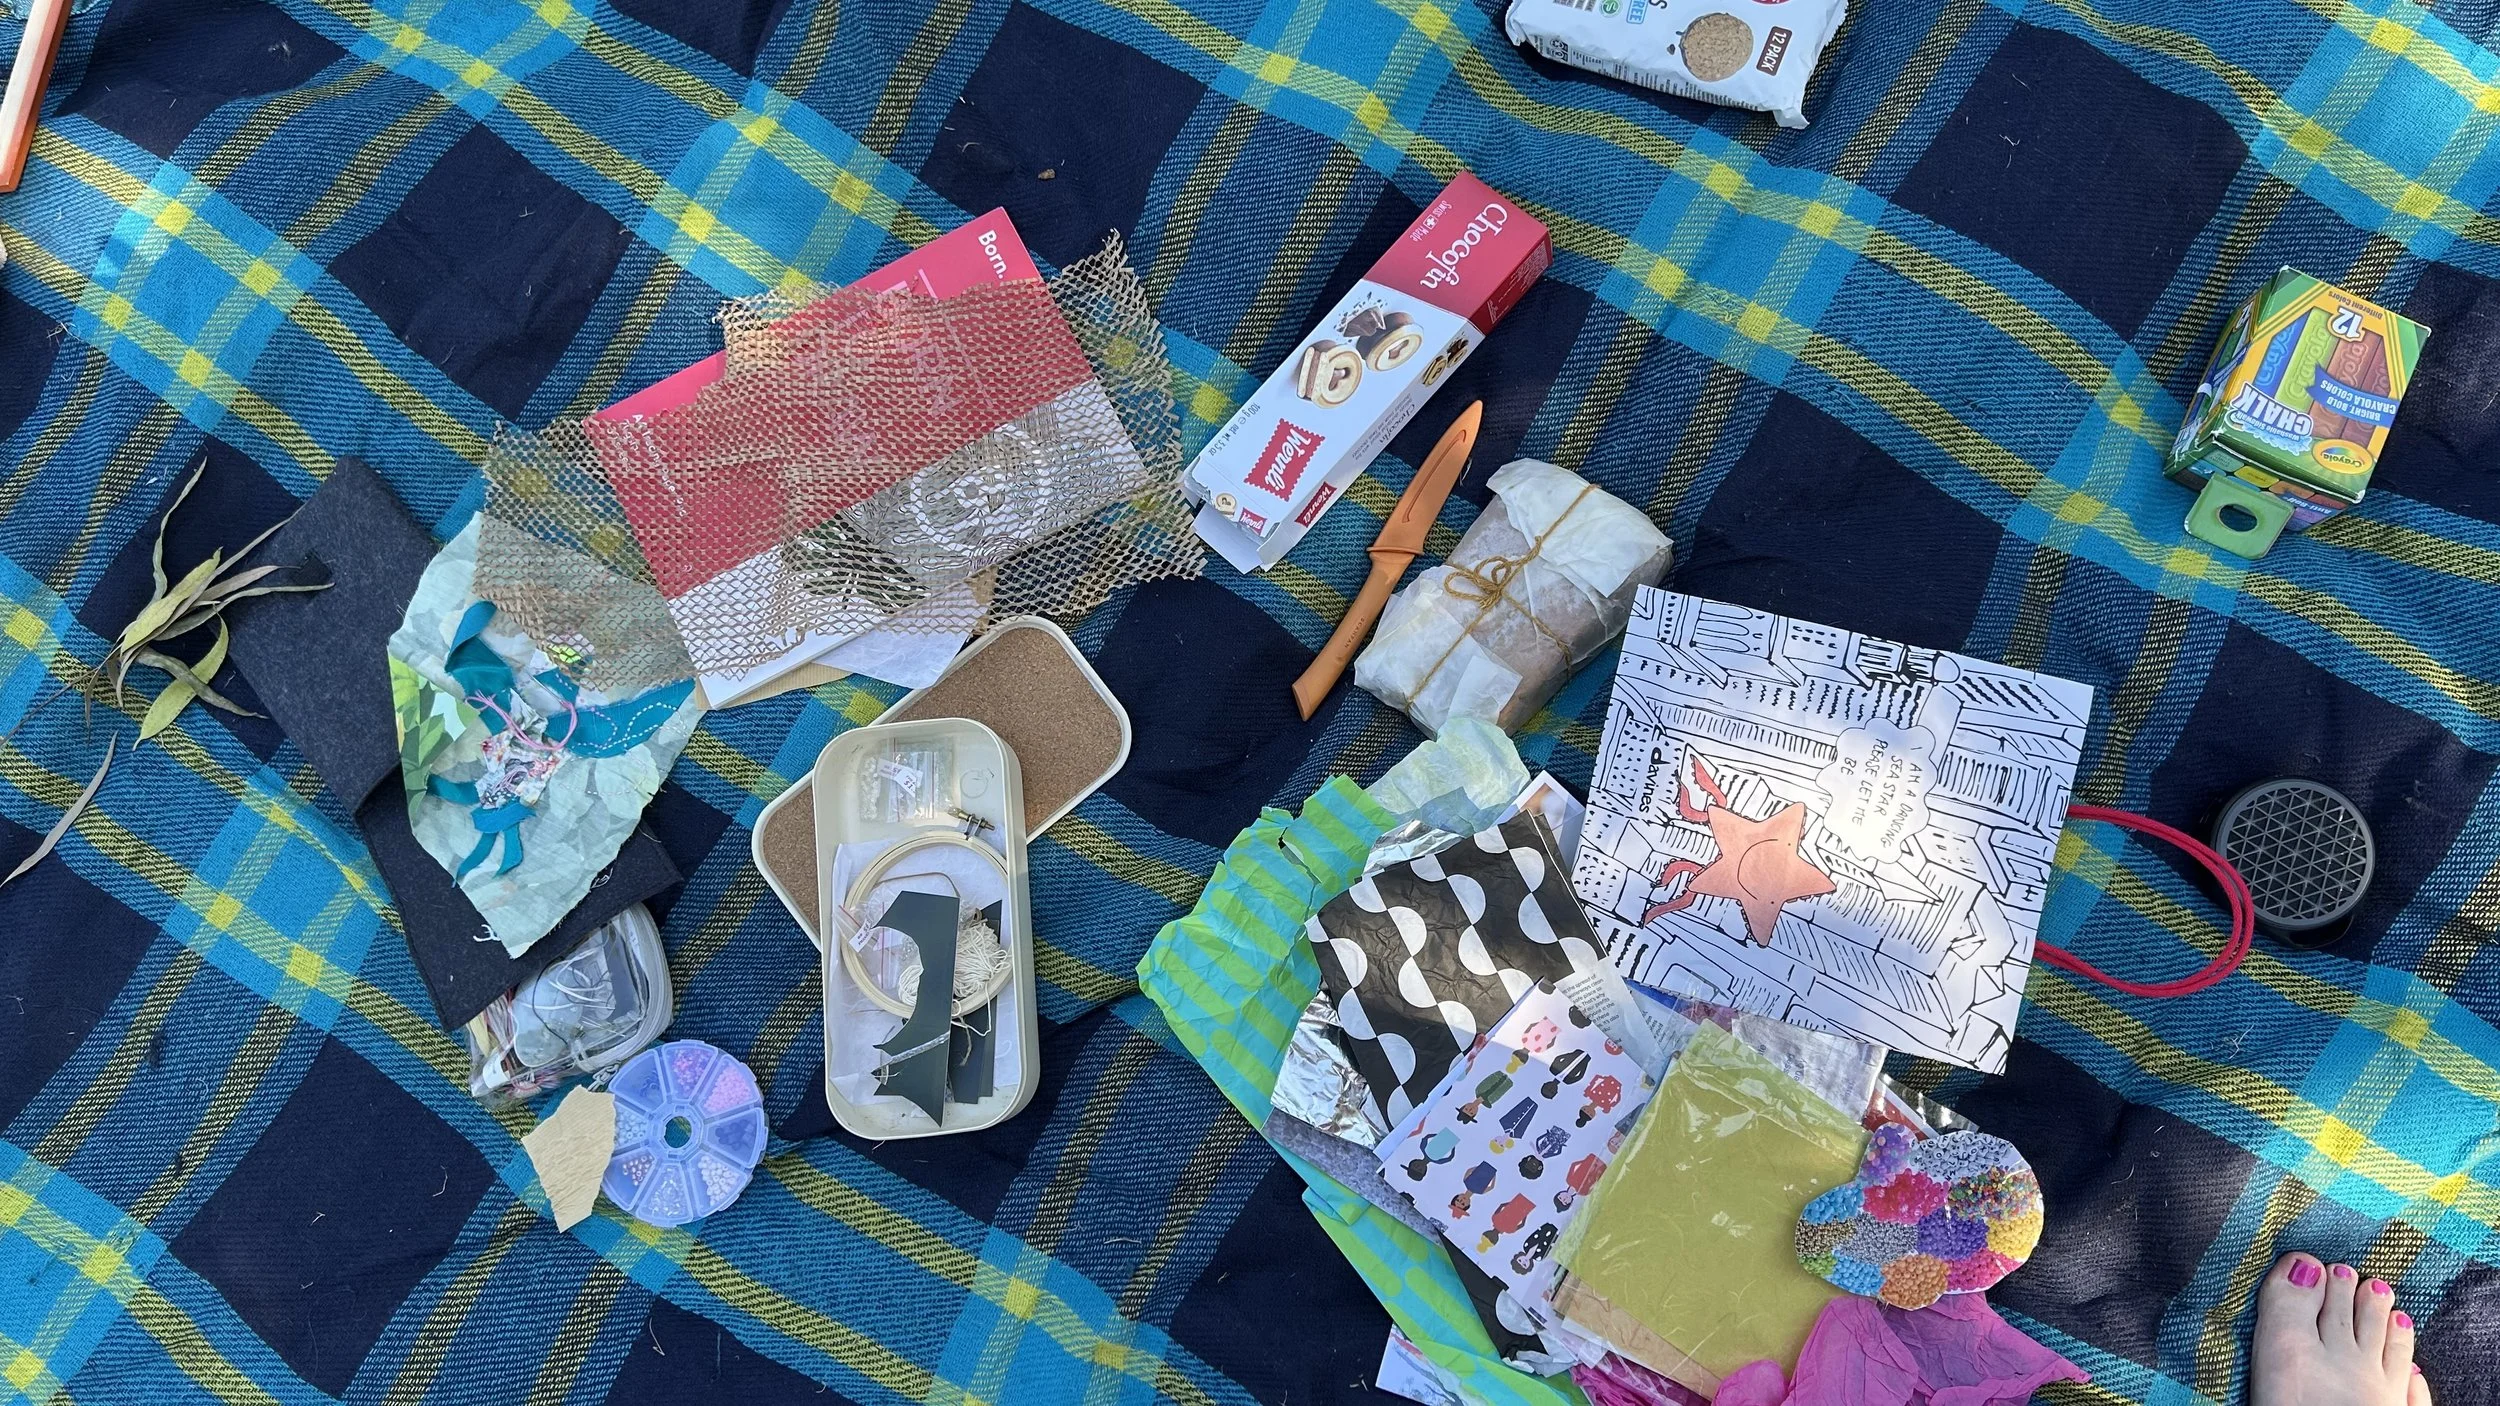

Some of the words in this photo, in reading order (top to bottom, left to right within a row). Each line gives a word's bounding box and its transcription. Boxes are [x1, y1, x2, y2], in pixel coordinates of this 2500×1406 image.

[1771, 32, 1787, 44] 12
[1761, 44, 1782, 72] PACK
[1432, 200, 1452, 217] Swiss
[1410, 226, 1429, 242] Made
[1420, 203, 1508, 289] Chocofin
[978, 229, 1008, 279] Born.
[2328, 290, 2352, 306] Colors
[2351, 299, 2383, 320] Different
[2332, 307, 2364, 339] 12
[2320, 380, 2354, 404] COLORS
[2326, 396, 2347, 412] BOLD
[2234, 385, 2312, 436] CHALK
[2355, 396, 2397, 415] CRAYOLA
[2266, 423, 2300, 442] Washable
[1264, 428, 1312, 491] Wernli
[2323, 453, 2363, 468] Crayola
[1303, 486, 1332, 524] Wernli
[1840, 756, 1857, 776] BE
[1865, 738, 1889, 778] PLEASE
[1886, 755, 1903, 779] SEA
[1639, 747, 1671, 813] davines
[1907, 762, 1923, 784] AM
[1857, 780, 1873, 804] LET
[1873, 782, 1896, 816] STAR
[1905, 789, 1917, 798] A
[1852, 806, 1866, 826] ME
[1880, 802, 1914, 848] DANCING
